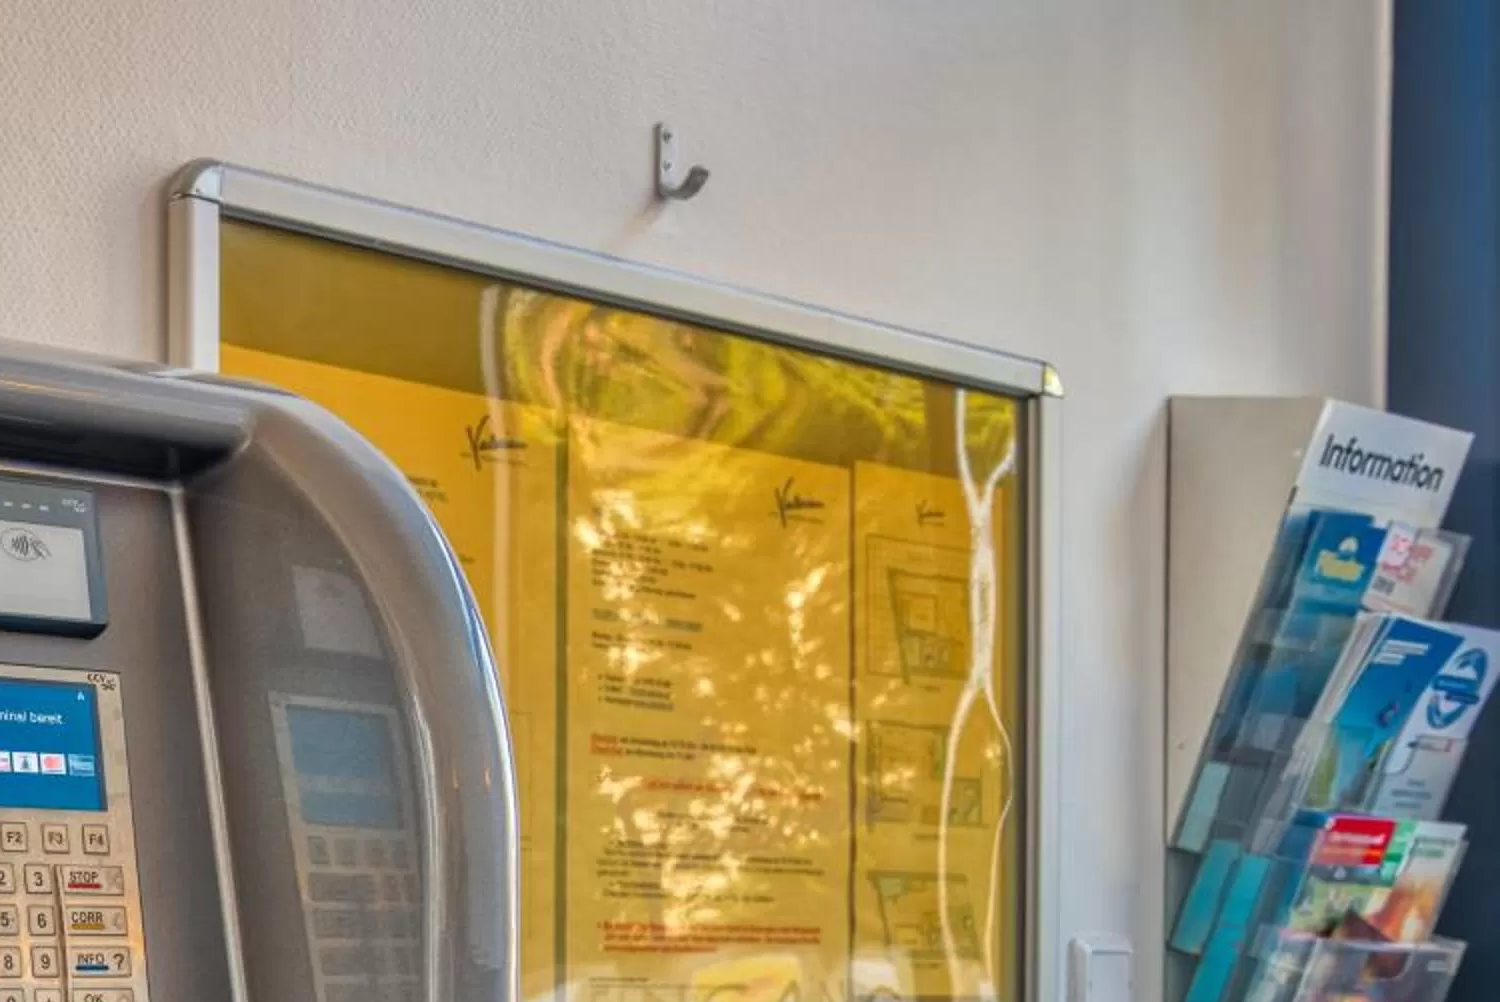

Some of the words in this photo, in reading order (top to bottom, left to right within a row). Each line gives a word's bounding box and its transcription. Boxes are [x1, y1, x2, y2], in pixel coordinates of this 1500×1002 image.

[1320, 433, 1445, 493] Information
[6, 830, 23, 845] F2
[48, 831, 63, 845] F3
[33, 871, 43, 887] 3
[69, 871, 99, 883] STOP
[0, 911, 10, 928] 5
[37, 913, 47, 929] 6
[71, 911, 104, 924] CORR
[3, 953, 13, 971] 8
[40, 953, 50, 970] 9
[77, 953, 105, 965] INFO
